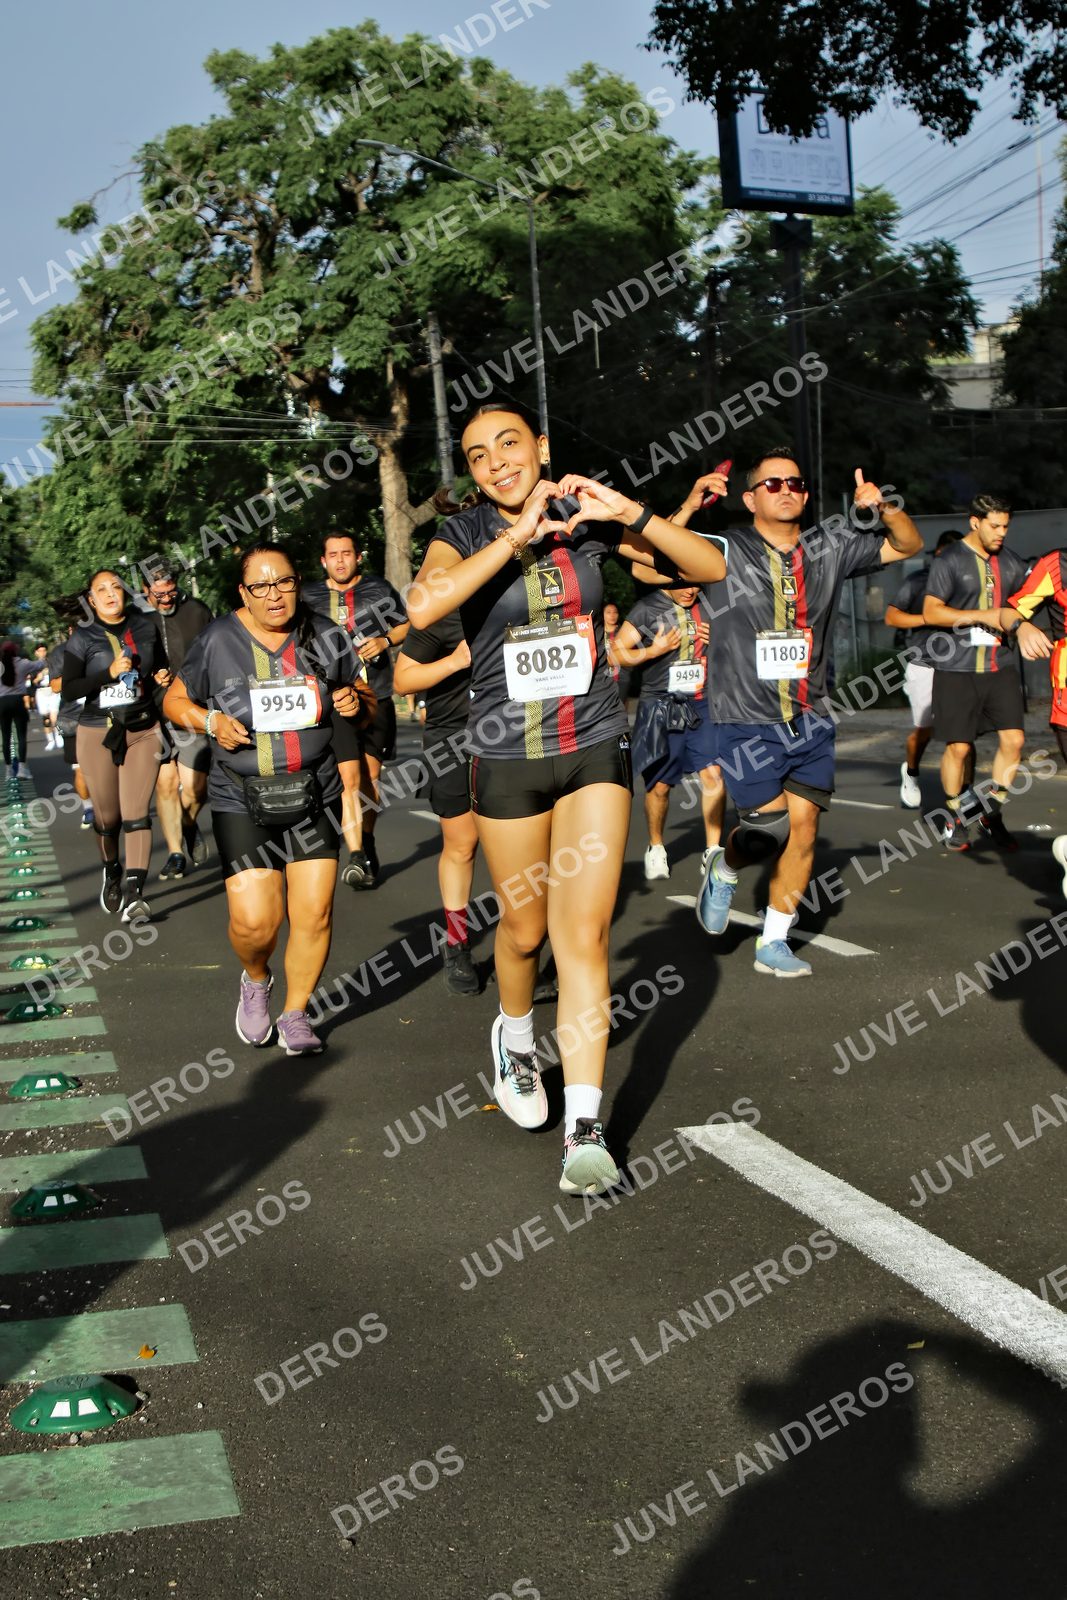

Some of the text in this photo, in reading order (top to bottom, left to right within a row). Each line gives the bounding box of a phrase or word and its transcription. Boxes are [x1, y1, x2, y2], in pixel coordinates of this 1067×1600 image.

[516, 644, 578, 676] 8082
[760, 646, 806, 661] 11803
[676, 669, 700, 681] 9494
[261, 693, 307, 712] 9954
